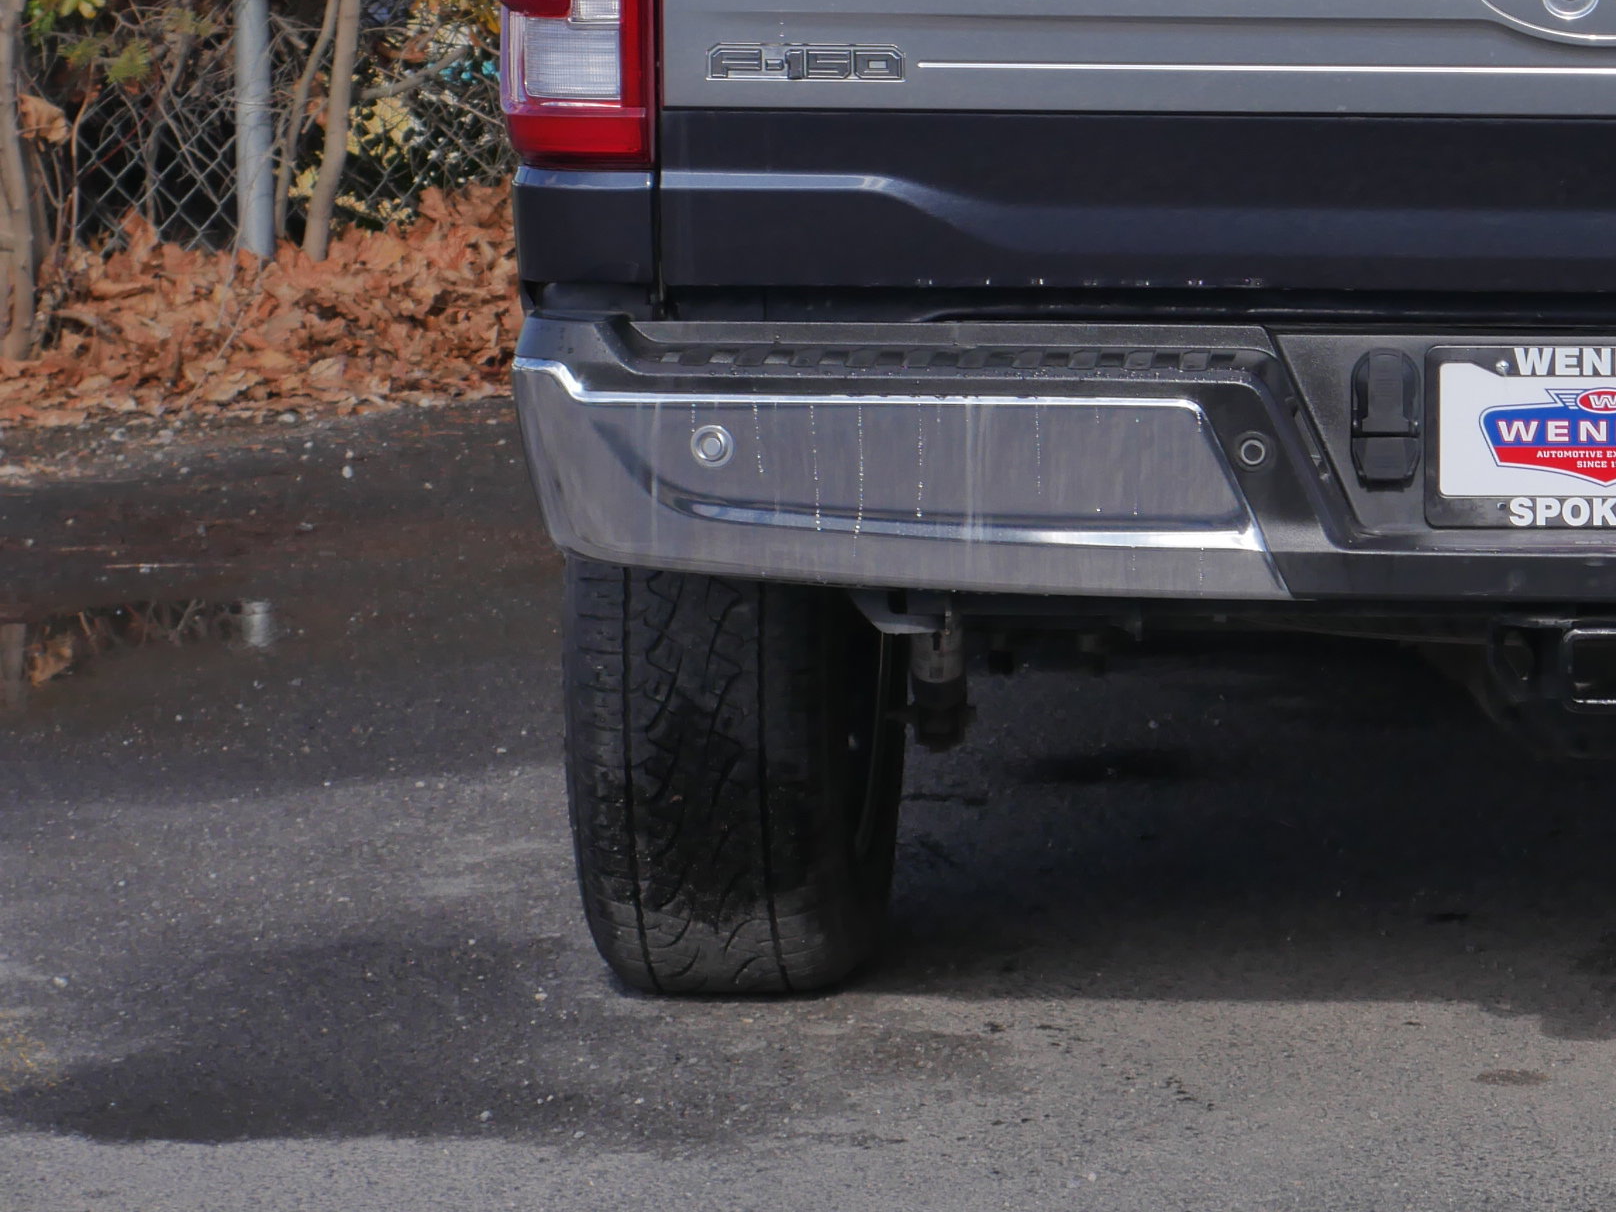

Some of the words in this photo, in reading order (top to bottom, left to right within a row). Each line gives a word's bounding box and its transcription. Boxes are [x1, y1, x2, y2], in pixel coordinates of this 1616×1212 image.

[708, 44, 904, 81] F-150
[1536, 450, 1603, 459] AUTOMOTIVE
[1576, 460, 1608, 469] SINCE
